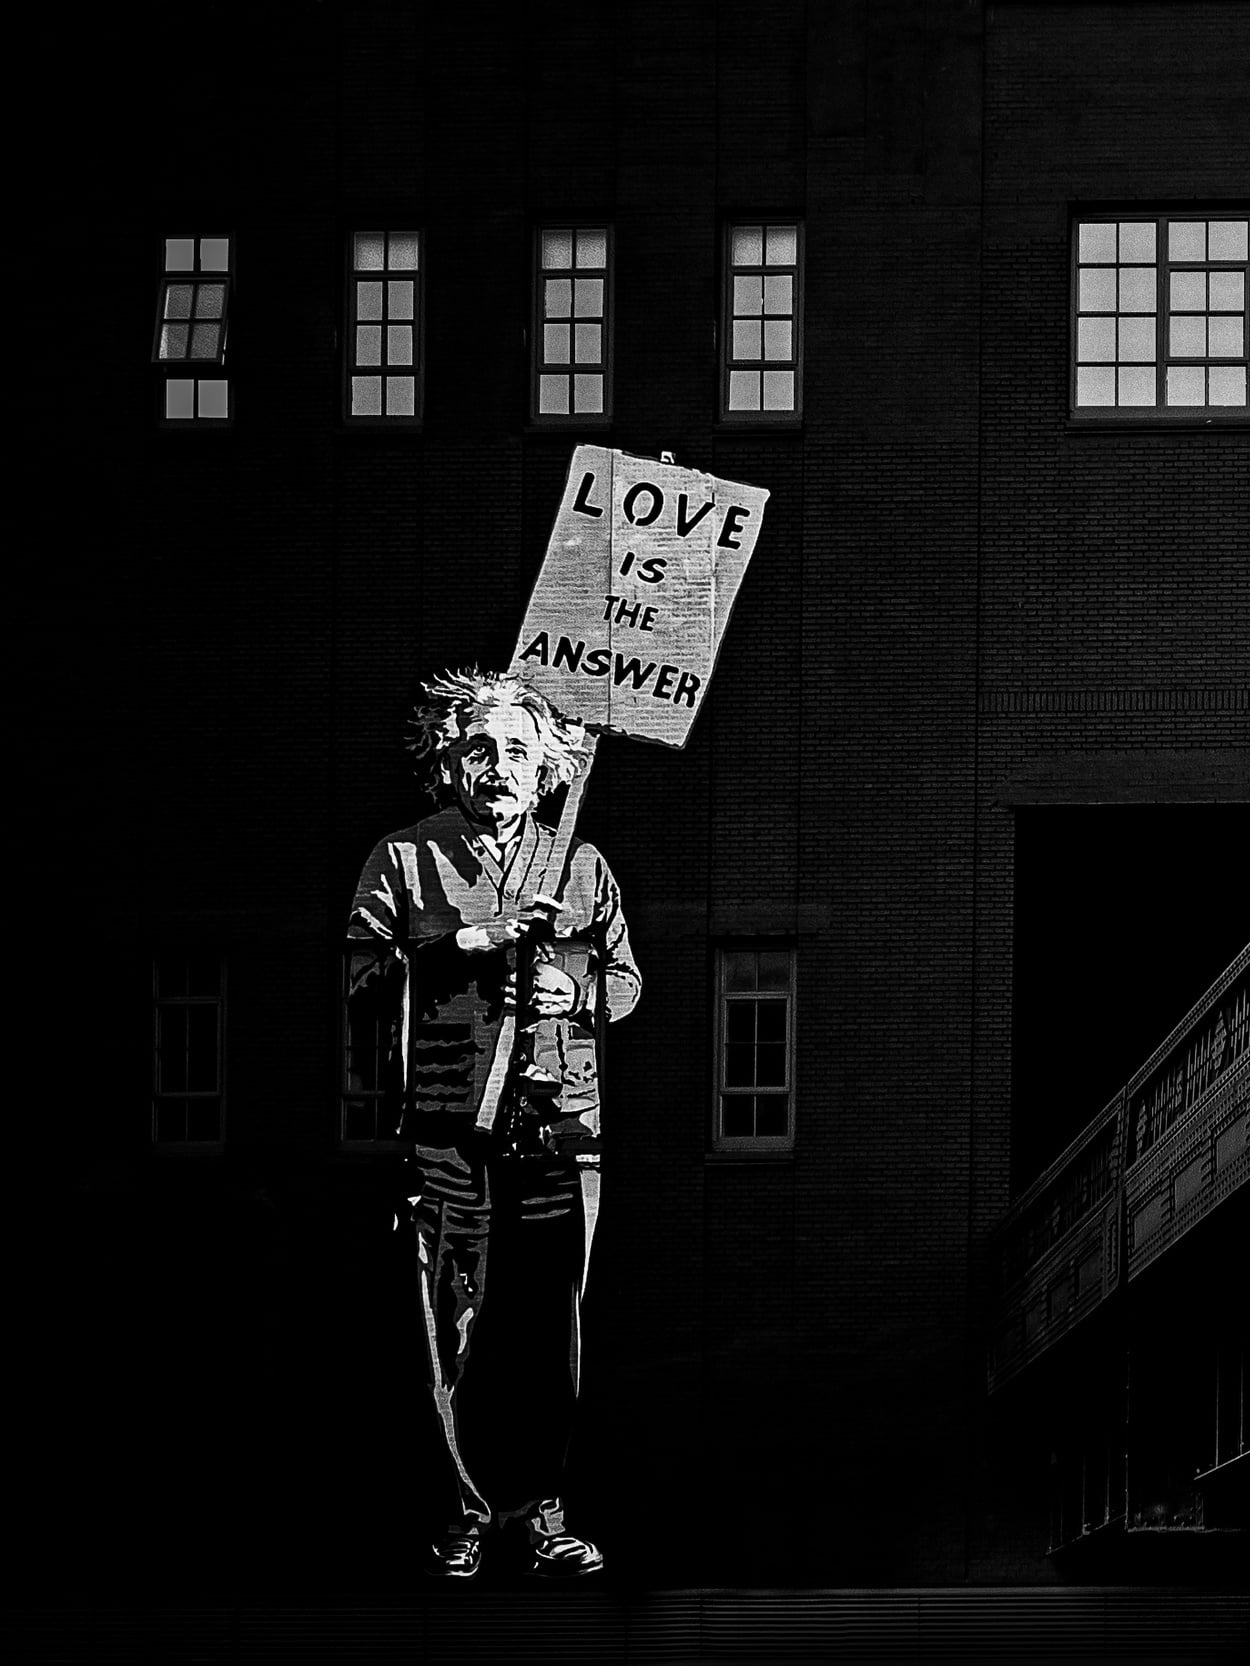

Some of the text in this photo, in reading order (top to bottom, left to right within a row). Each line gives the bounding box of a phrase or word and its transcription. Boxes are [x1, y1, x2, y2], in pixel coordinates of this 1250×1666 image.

[573, 472, 750, 549] LOVE
[620, 552, 667, 583] IS
[604, 595, 659, 631] THE
[519, 632, 701, 708] ANSWER
